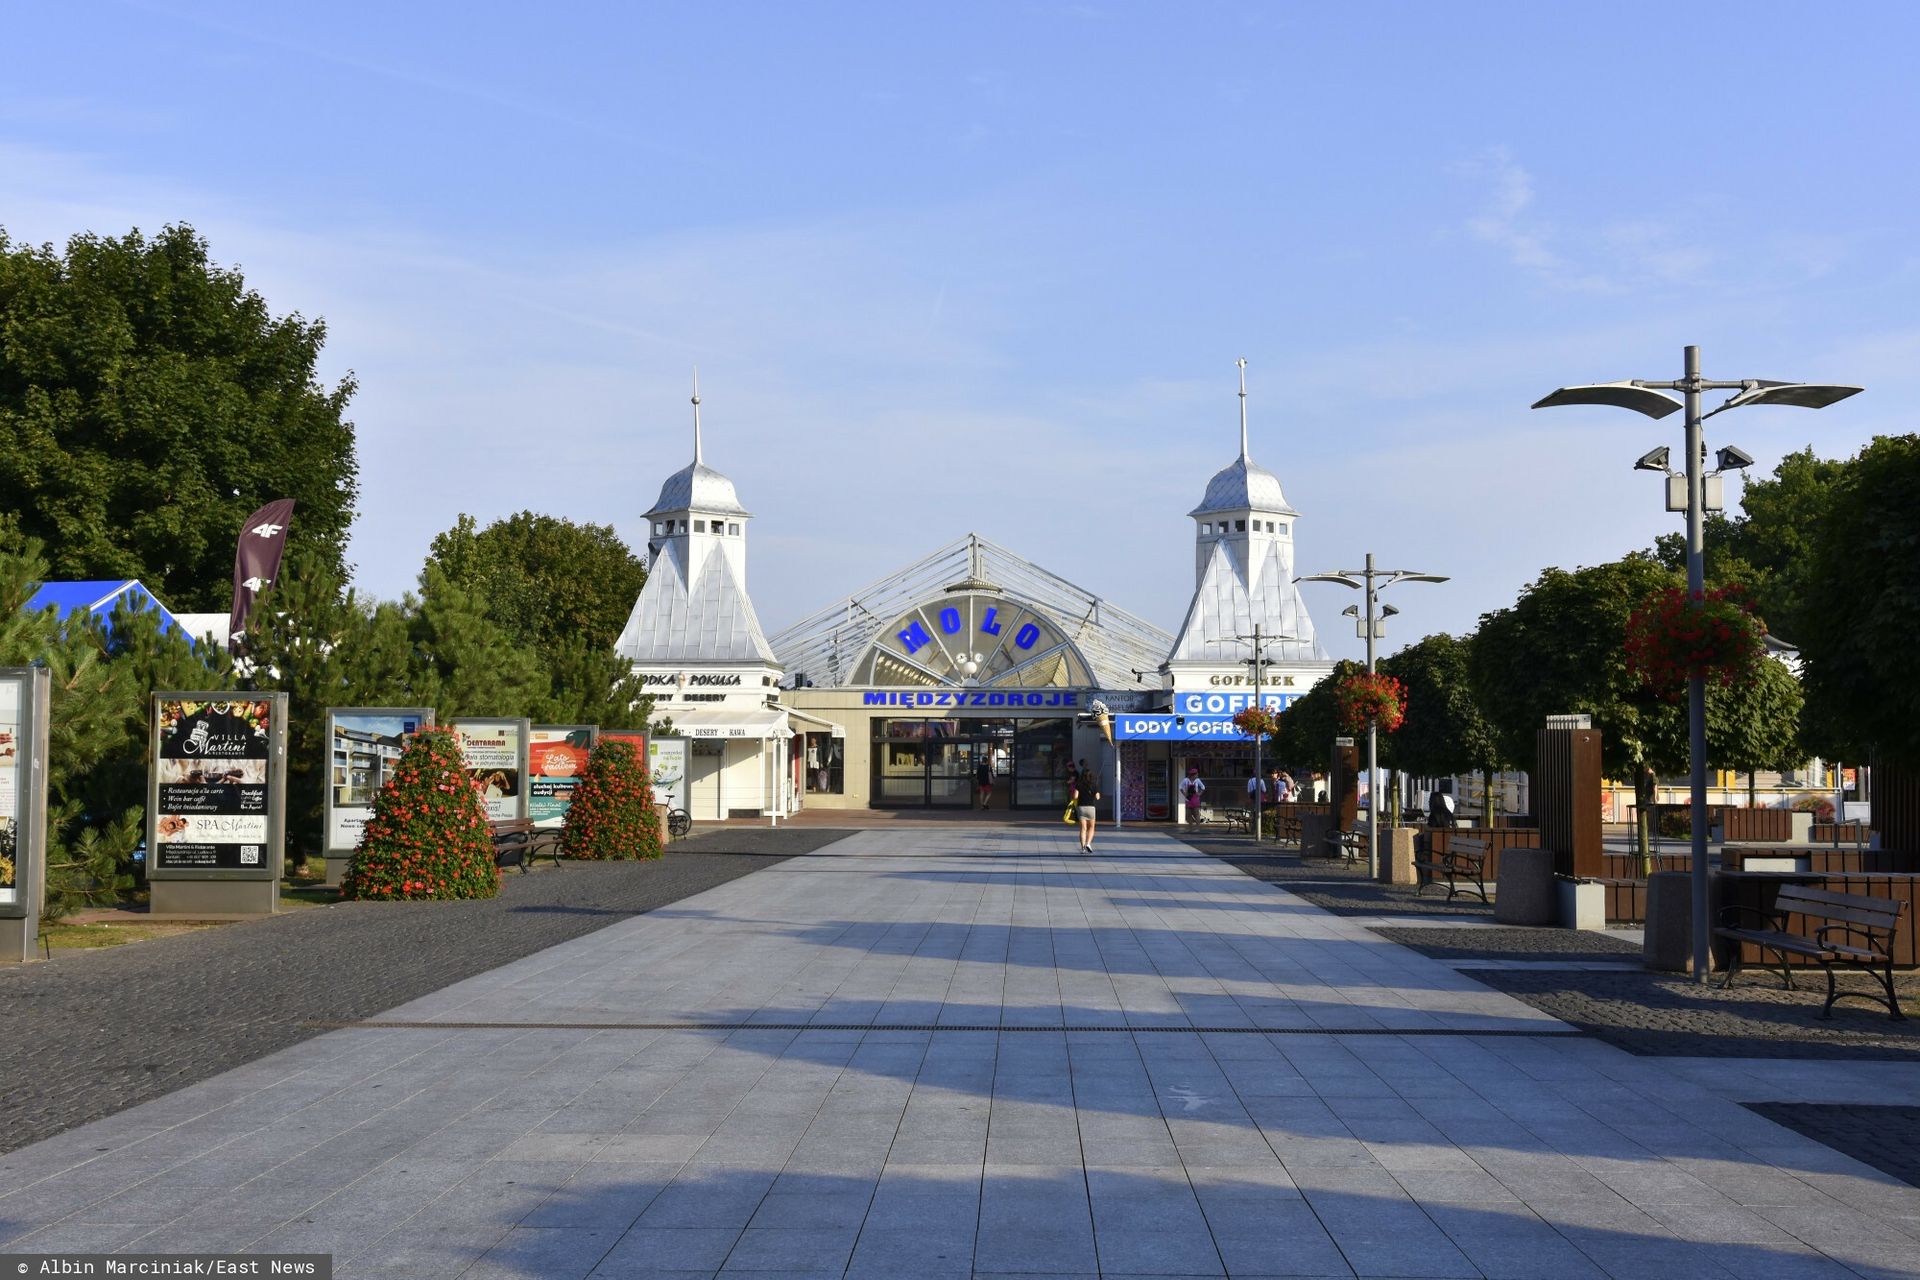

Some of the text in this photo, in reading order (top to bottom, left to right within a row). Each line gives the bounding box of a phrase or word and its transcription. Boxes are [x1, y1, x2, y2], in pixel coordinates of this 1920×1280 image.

[251, 523, 283, 539] 4F
[897, 607, 1041, 655] MOLO
[689, 674, 742, 687] POKUSA
[683, 693, 727, 702] DESERY
[863, 691, 1079, 710] MIĘDZYZDROJE
[1125, 720, 1172, 734] LODY
[183, 736, 247, 755] Martini
[196, 819, 219, 831] SPA
